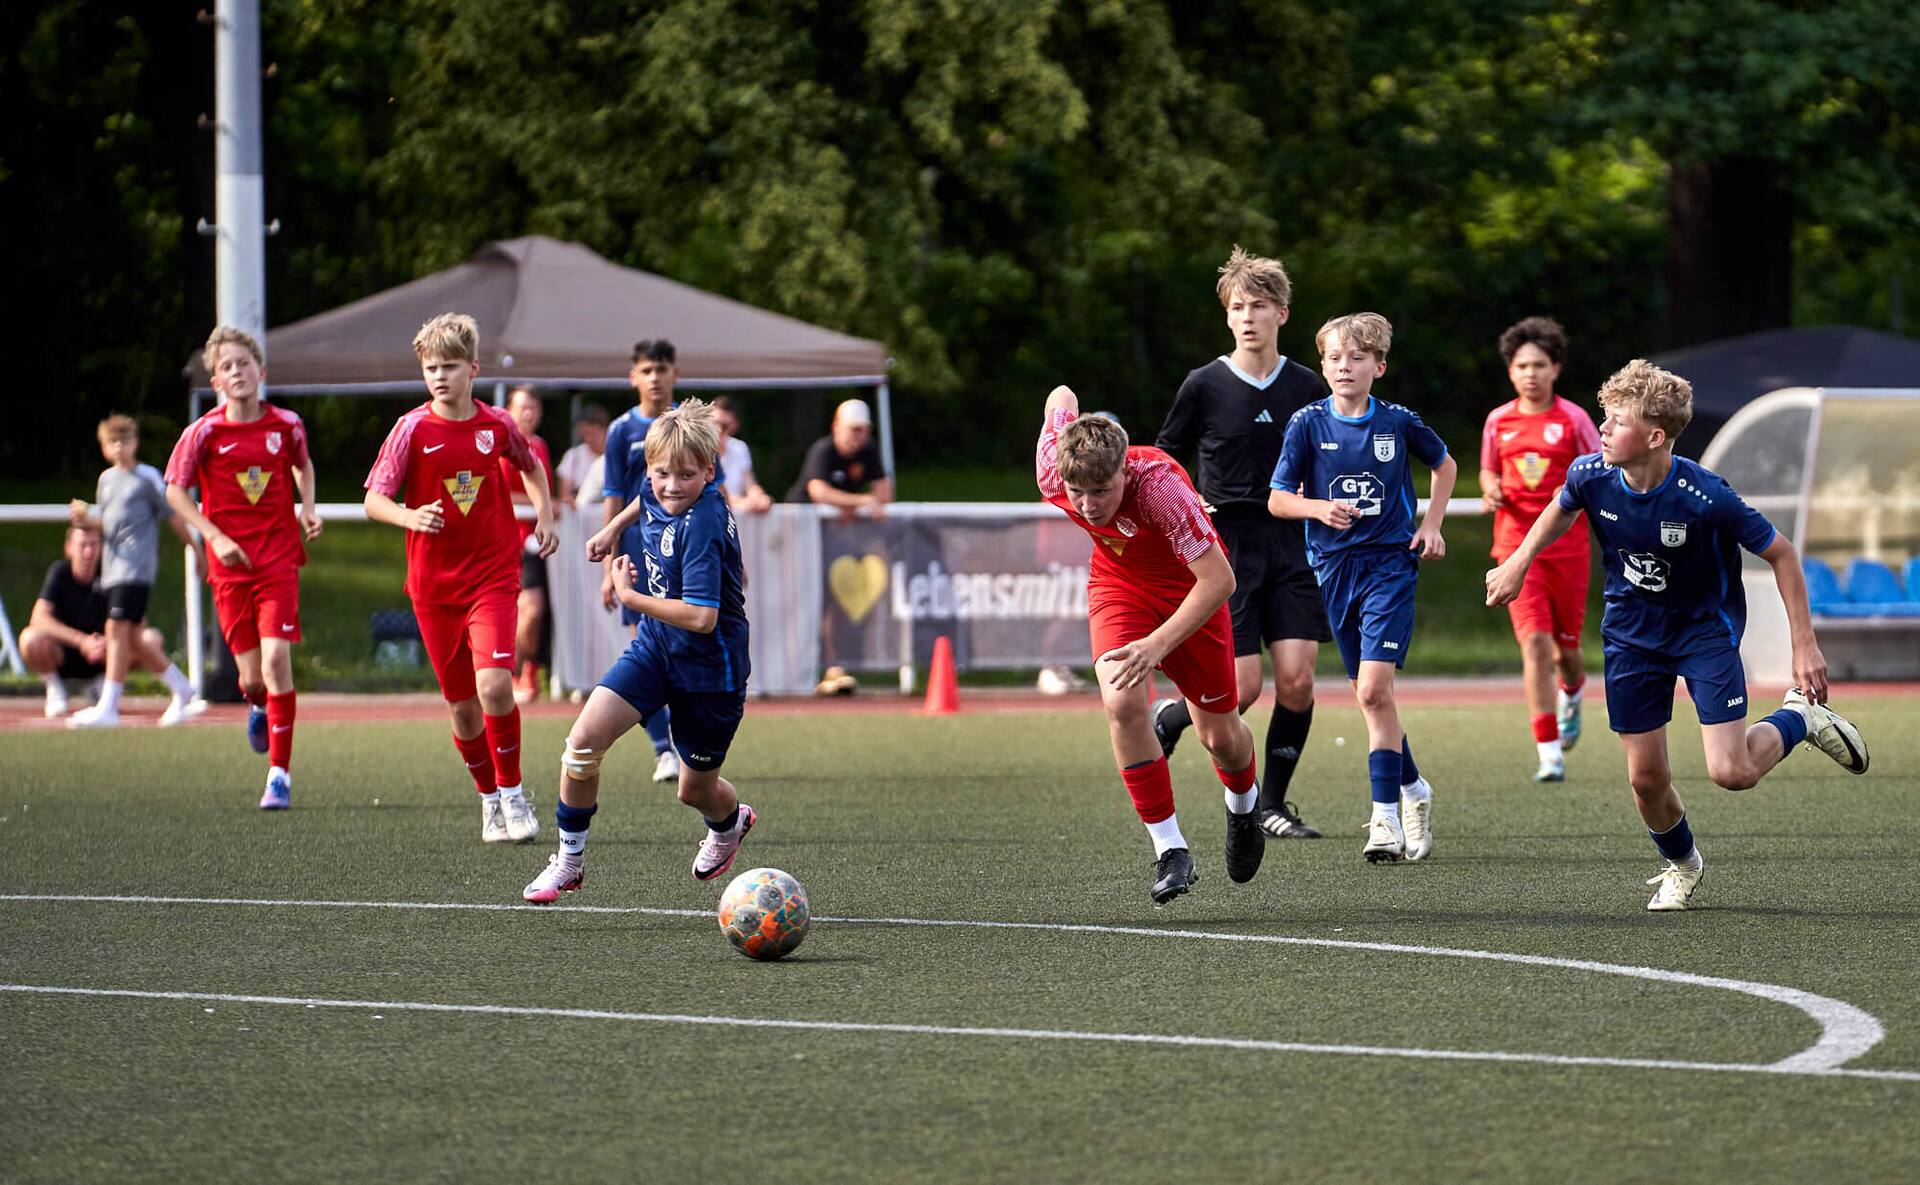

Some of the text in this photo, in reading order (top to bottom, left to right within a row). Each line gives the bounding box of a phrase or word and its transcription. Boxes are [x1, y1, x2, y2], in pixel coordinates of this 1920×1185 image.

[1320, 442, 1339, 450] JAKO
[1599, 508, 1619, 521] JAKO
[1382, 640, 1399, 650] JAKO
[1727, 695, 1744, 708] JAKO
